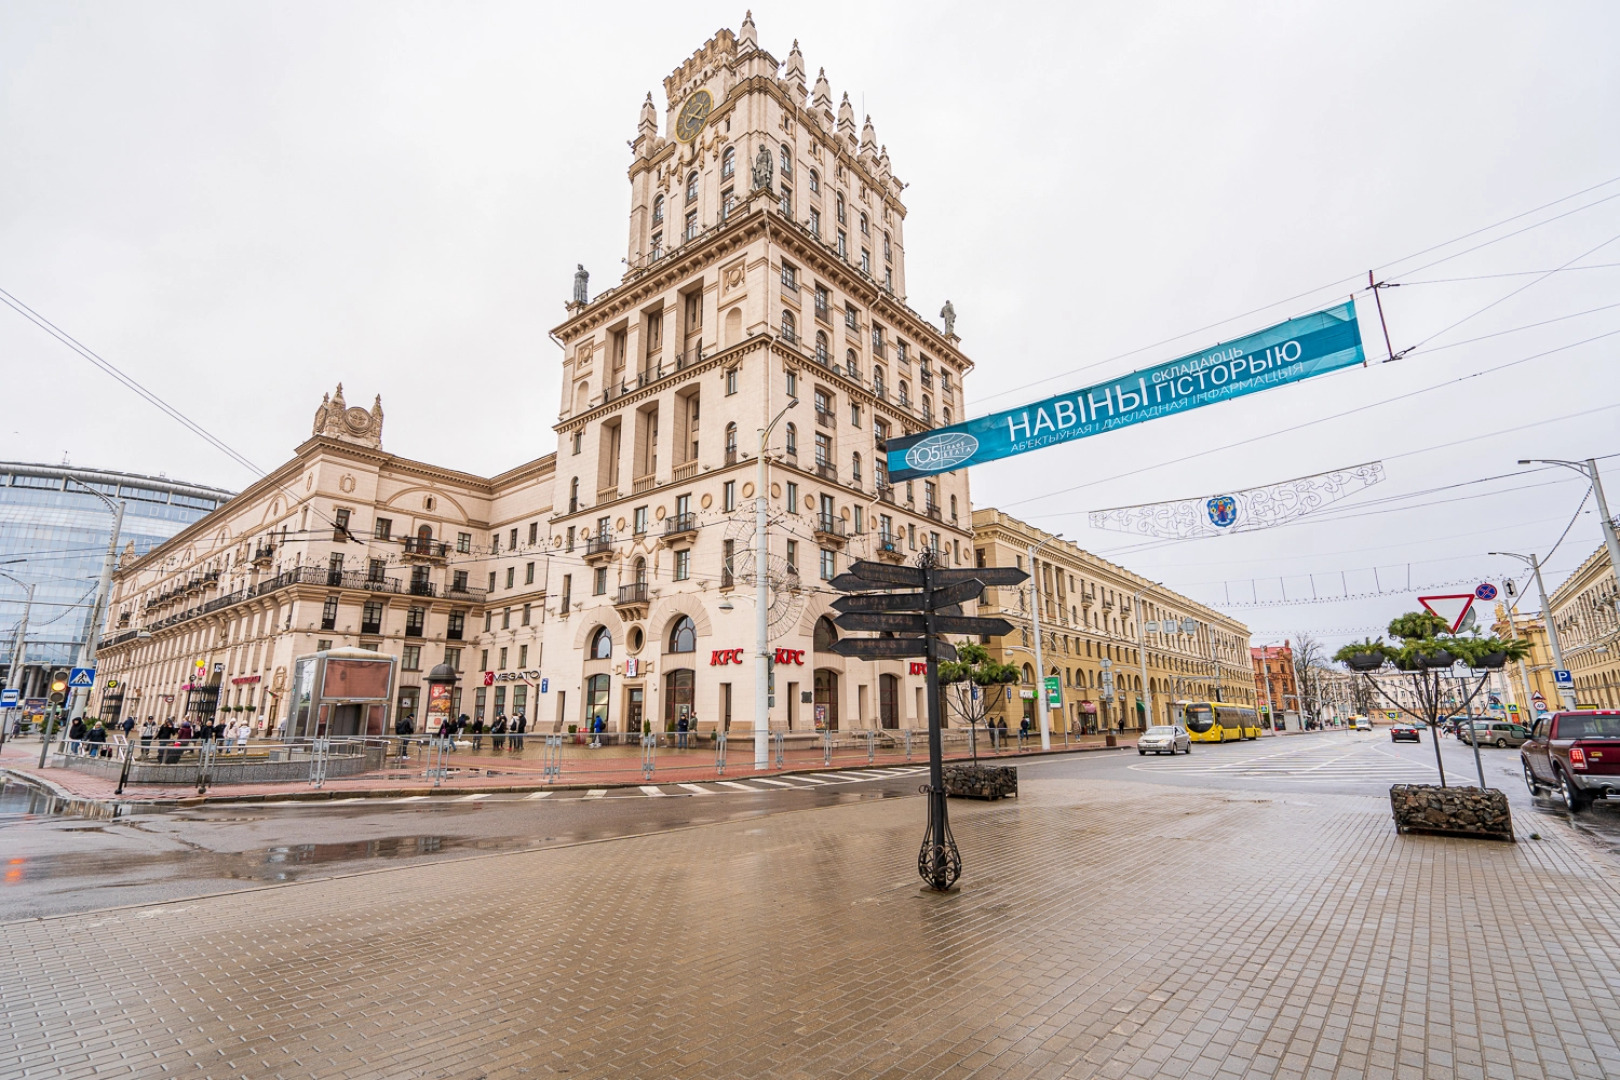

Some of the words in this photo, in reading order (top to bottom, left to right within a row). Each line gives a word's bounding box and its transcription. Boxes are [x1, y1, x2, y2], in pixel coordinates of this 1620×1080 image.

[1152, 347, 1243, 383] СКЛАДАЮЦЬ
[1007, 377, 1149, 442] НАВІНЫ
[1155, 340, 1302, 402] ГІСТОРЫЮ
[1101, 397, 1188, 430] ДАКЛАДНАЯ
[1192, 361, 1304, 405] ІНФАРМАЦЫЯ
[912, 445, 940, 465] 105
[709, 648, 744, 666] KFC
[774, 647, 805, 666] KFC
[493, 670, 541, 682] MEGATO
[1558, 671, 1567, 681] P
